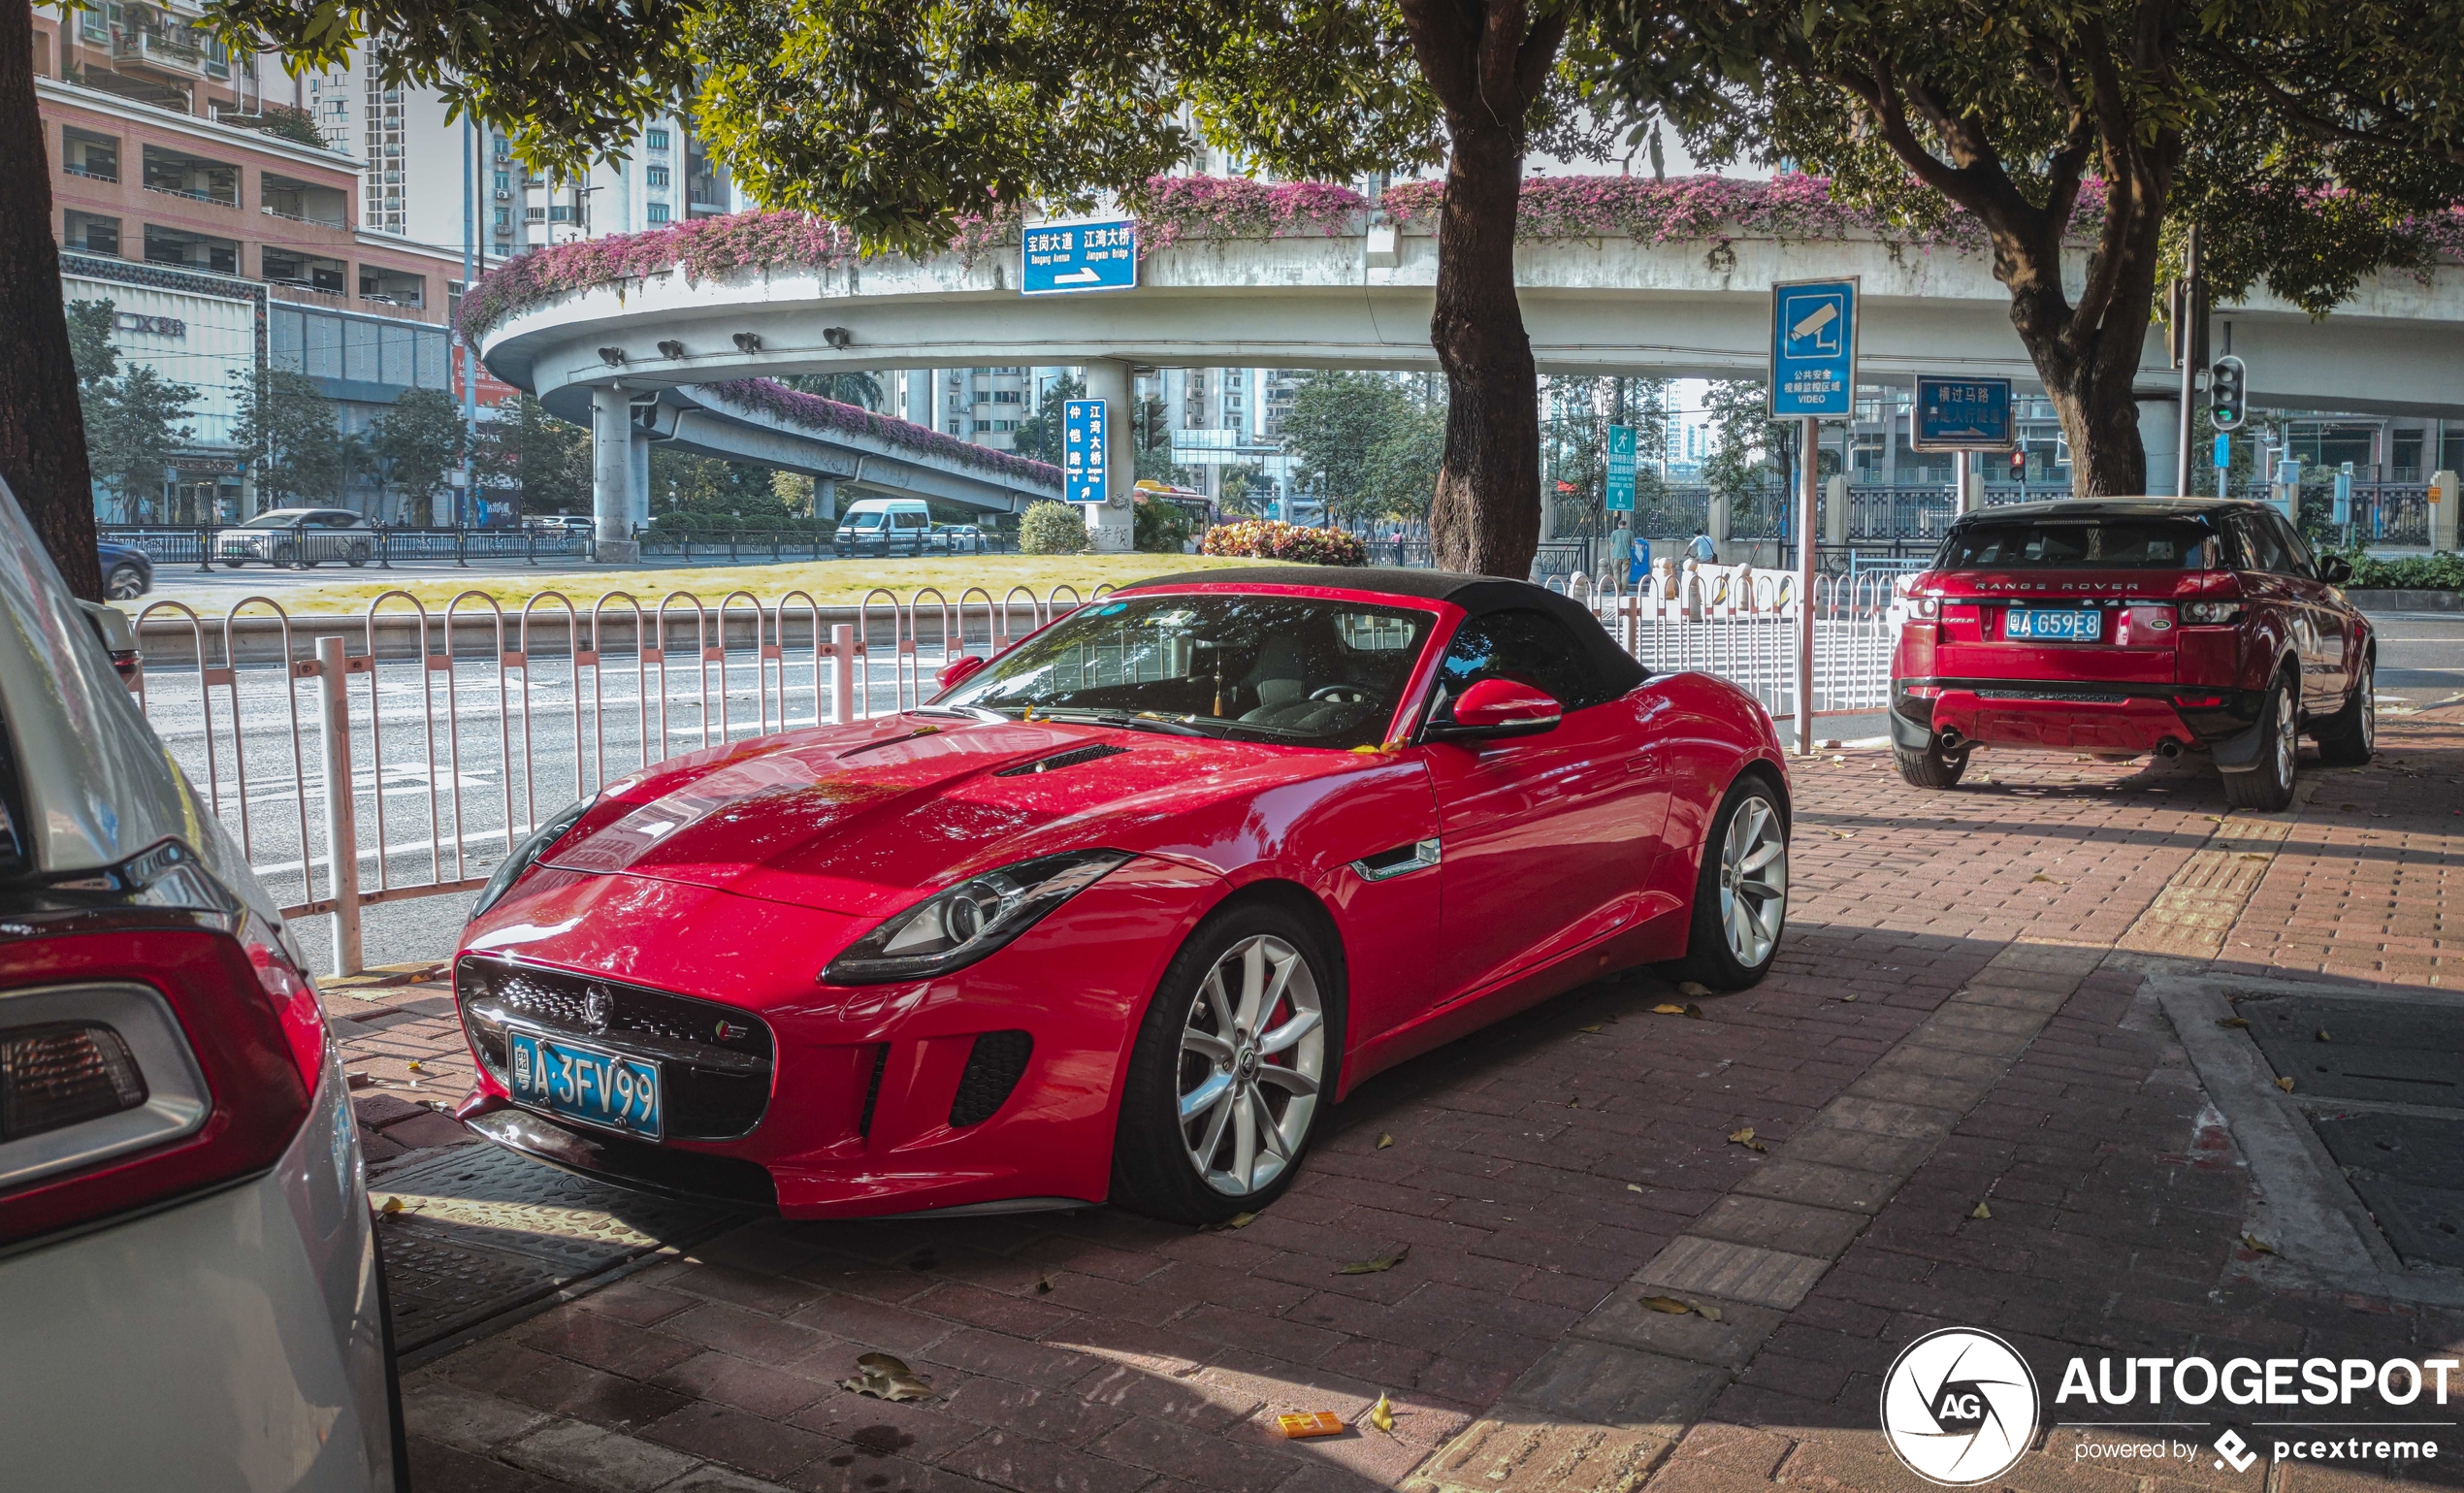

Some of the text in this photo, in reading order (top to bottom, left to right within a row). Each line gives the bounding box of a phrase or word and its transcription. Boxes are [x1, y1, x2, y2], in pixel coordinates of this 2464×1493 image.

[1027, 227, 1130, 252] 宝岗大道 江湾大桥
[1031, 253, 1070, 266] Baogang Avenue
[1086, 248, 1128, 262] Jiangwan Bridge
[1794, 369, 1832, 380] 公共安全
[1784, 381, 1841, 393] 视频监控区域
[1798, 395, 1826, 404] VIDEO
[1938, 386, 1990, 404] 横过马路
[1069, 406, 1082, 466] 仲恺路
[1089, 406, 1102, 466] 江湾大桥
